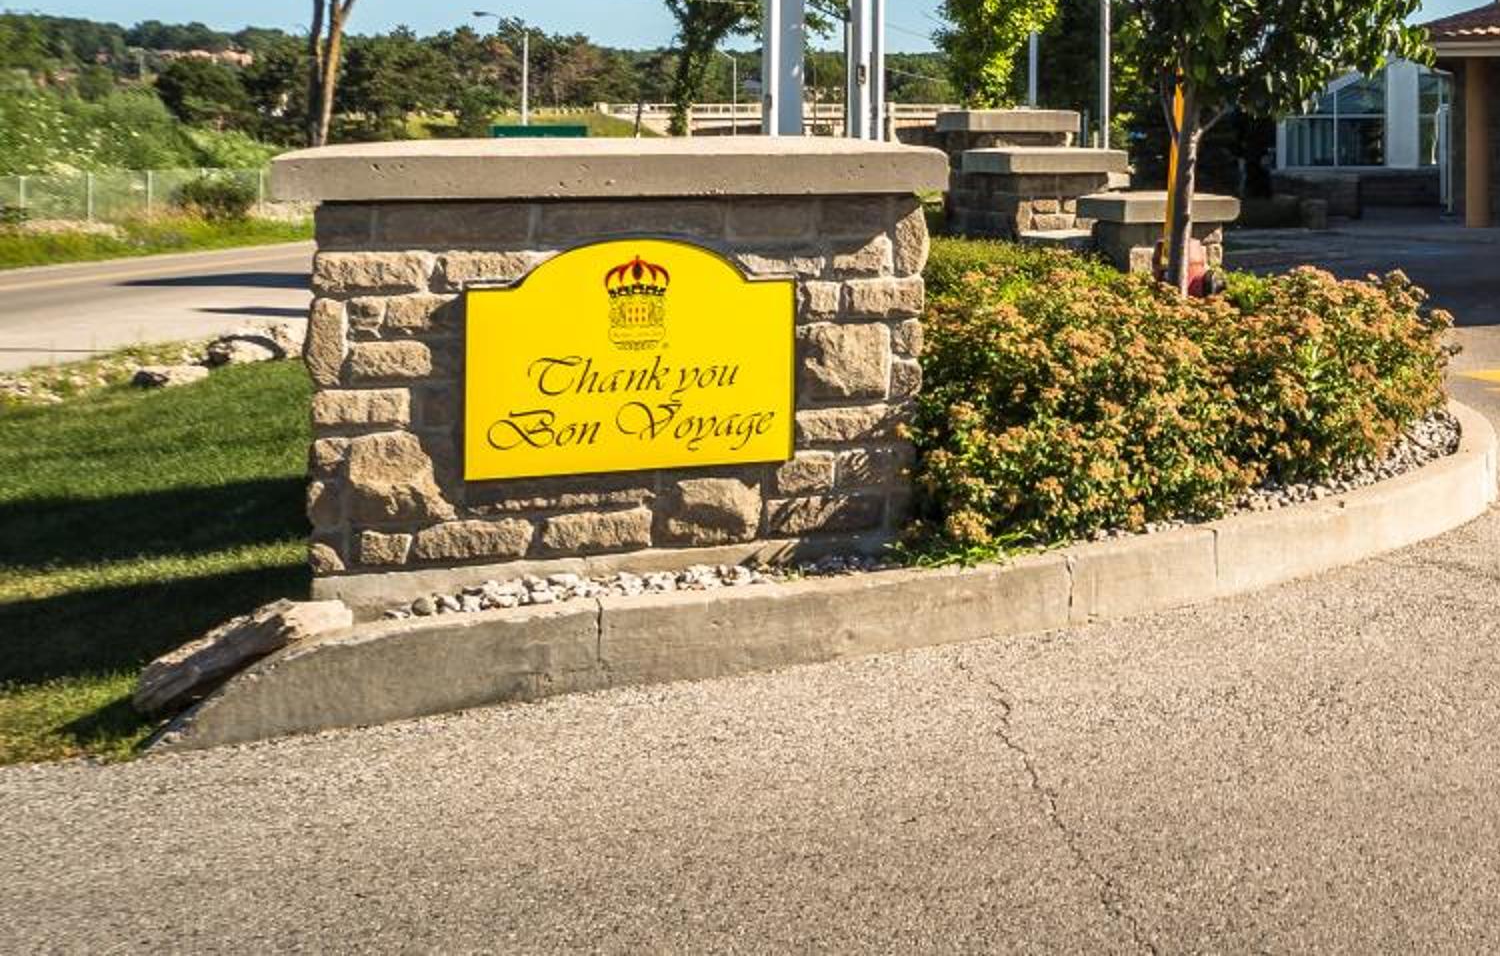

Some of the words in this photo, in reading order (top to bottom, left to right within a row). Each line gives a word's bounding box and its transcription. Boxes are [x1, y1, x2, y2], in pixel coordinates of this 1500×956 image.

[527, 355, 671, 397] Thank
[669, 363, 739, 402] you
[487, 409, 601, 451] Bon
[615, 401, 775, 452] Voyage
